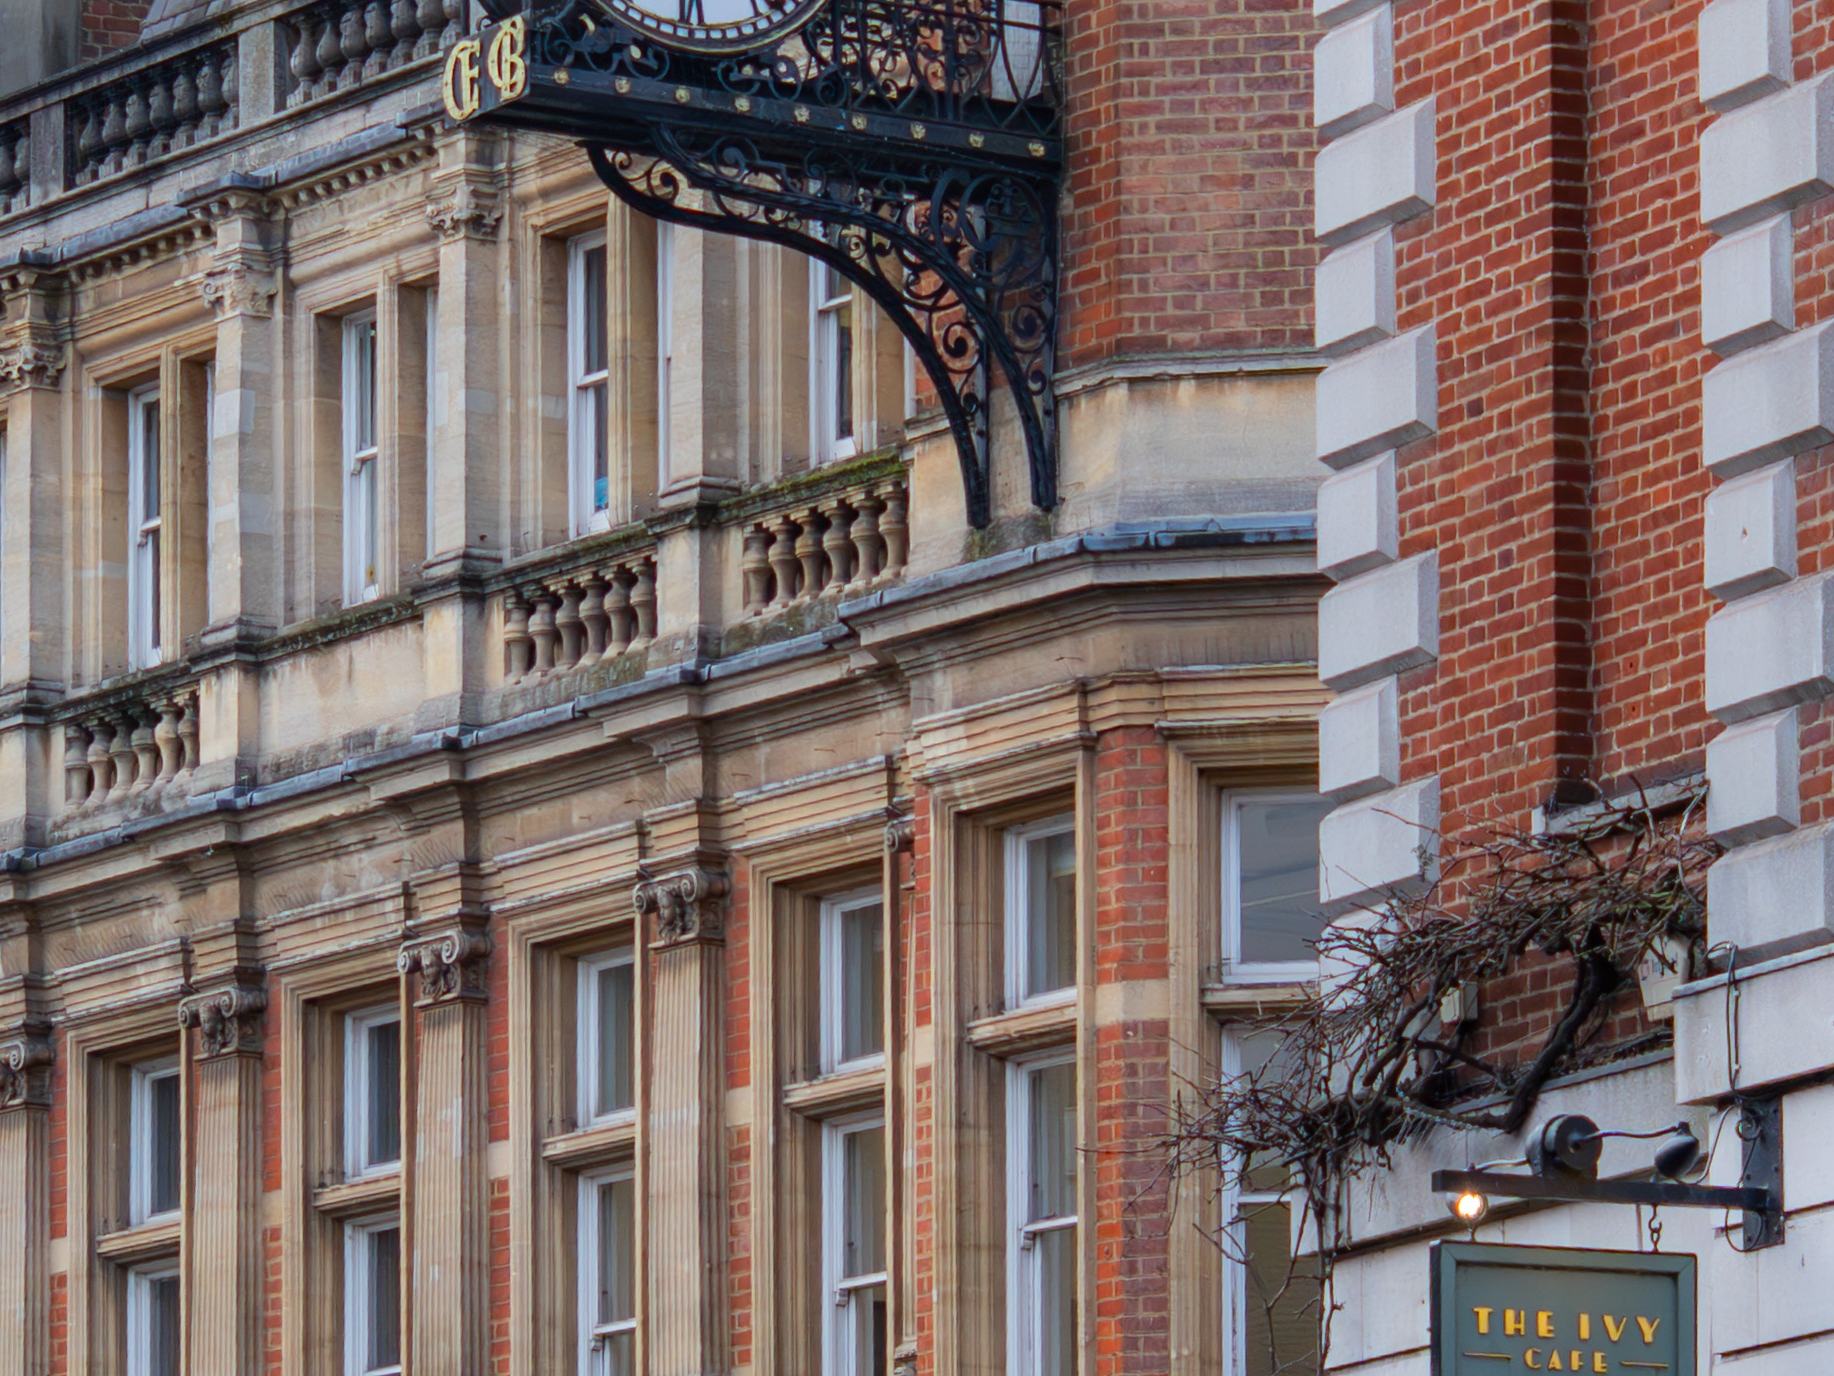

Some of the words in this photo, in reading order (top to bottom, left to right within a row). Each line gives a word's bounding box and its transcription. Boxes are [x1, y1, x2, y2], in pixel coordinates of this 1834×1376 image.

[1472, 1306, 1556, 1339] THE
[1577, 1312, 1662, 1344] IVY
[1523, 1347, 1609, 1374] CAFE
